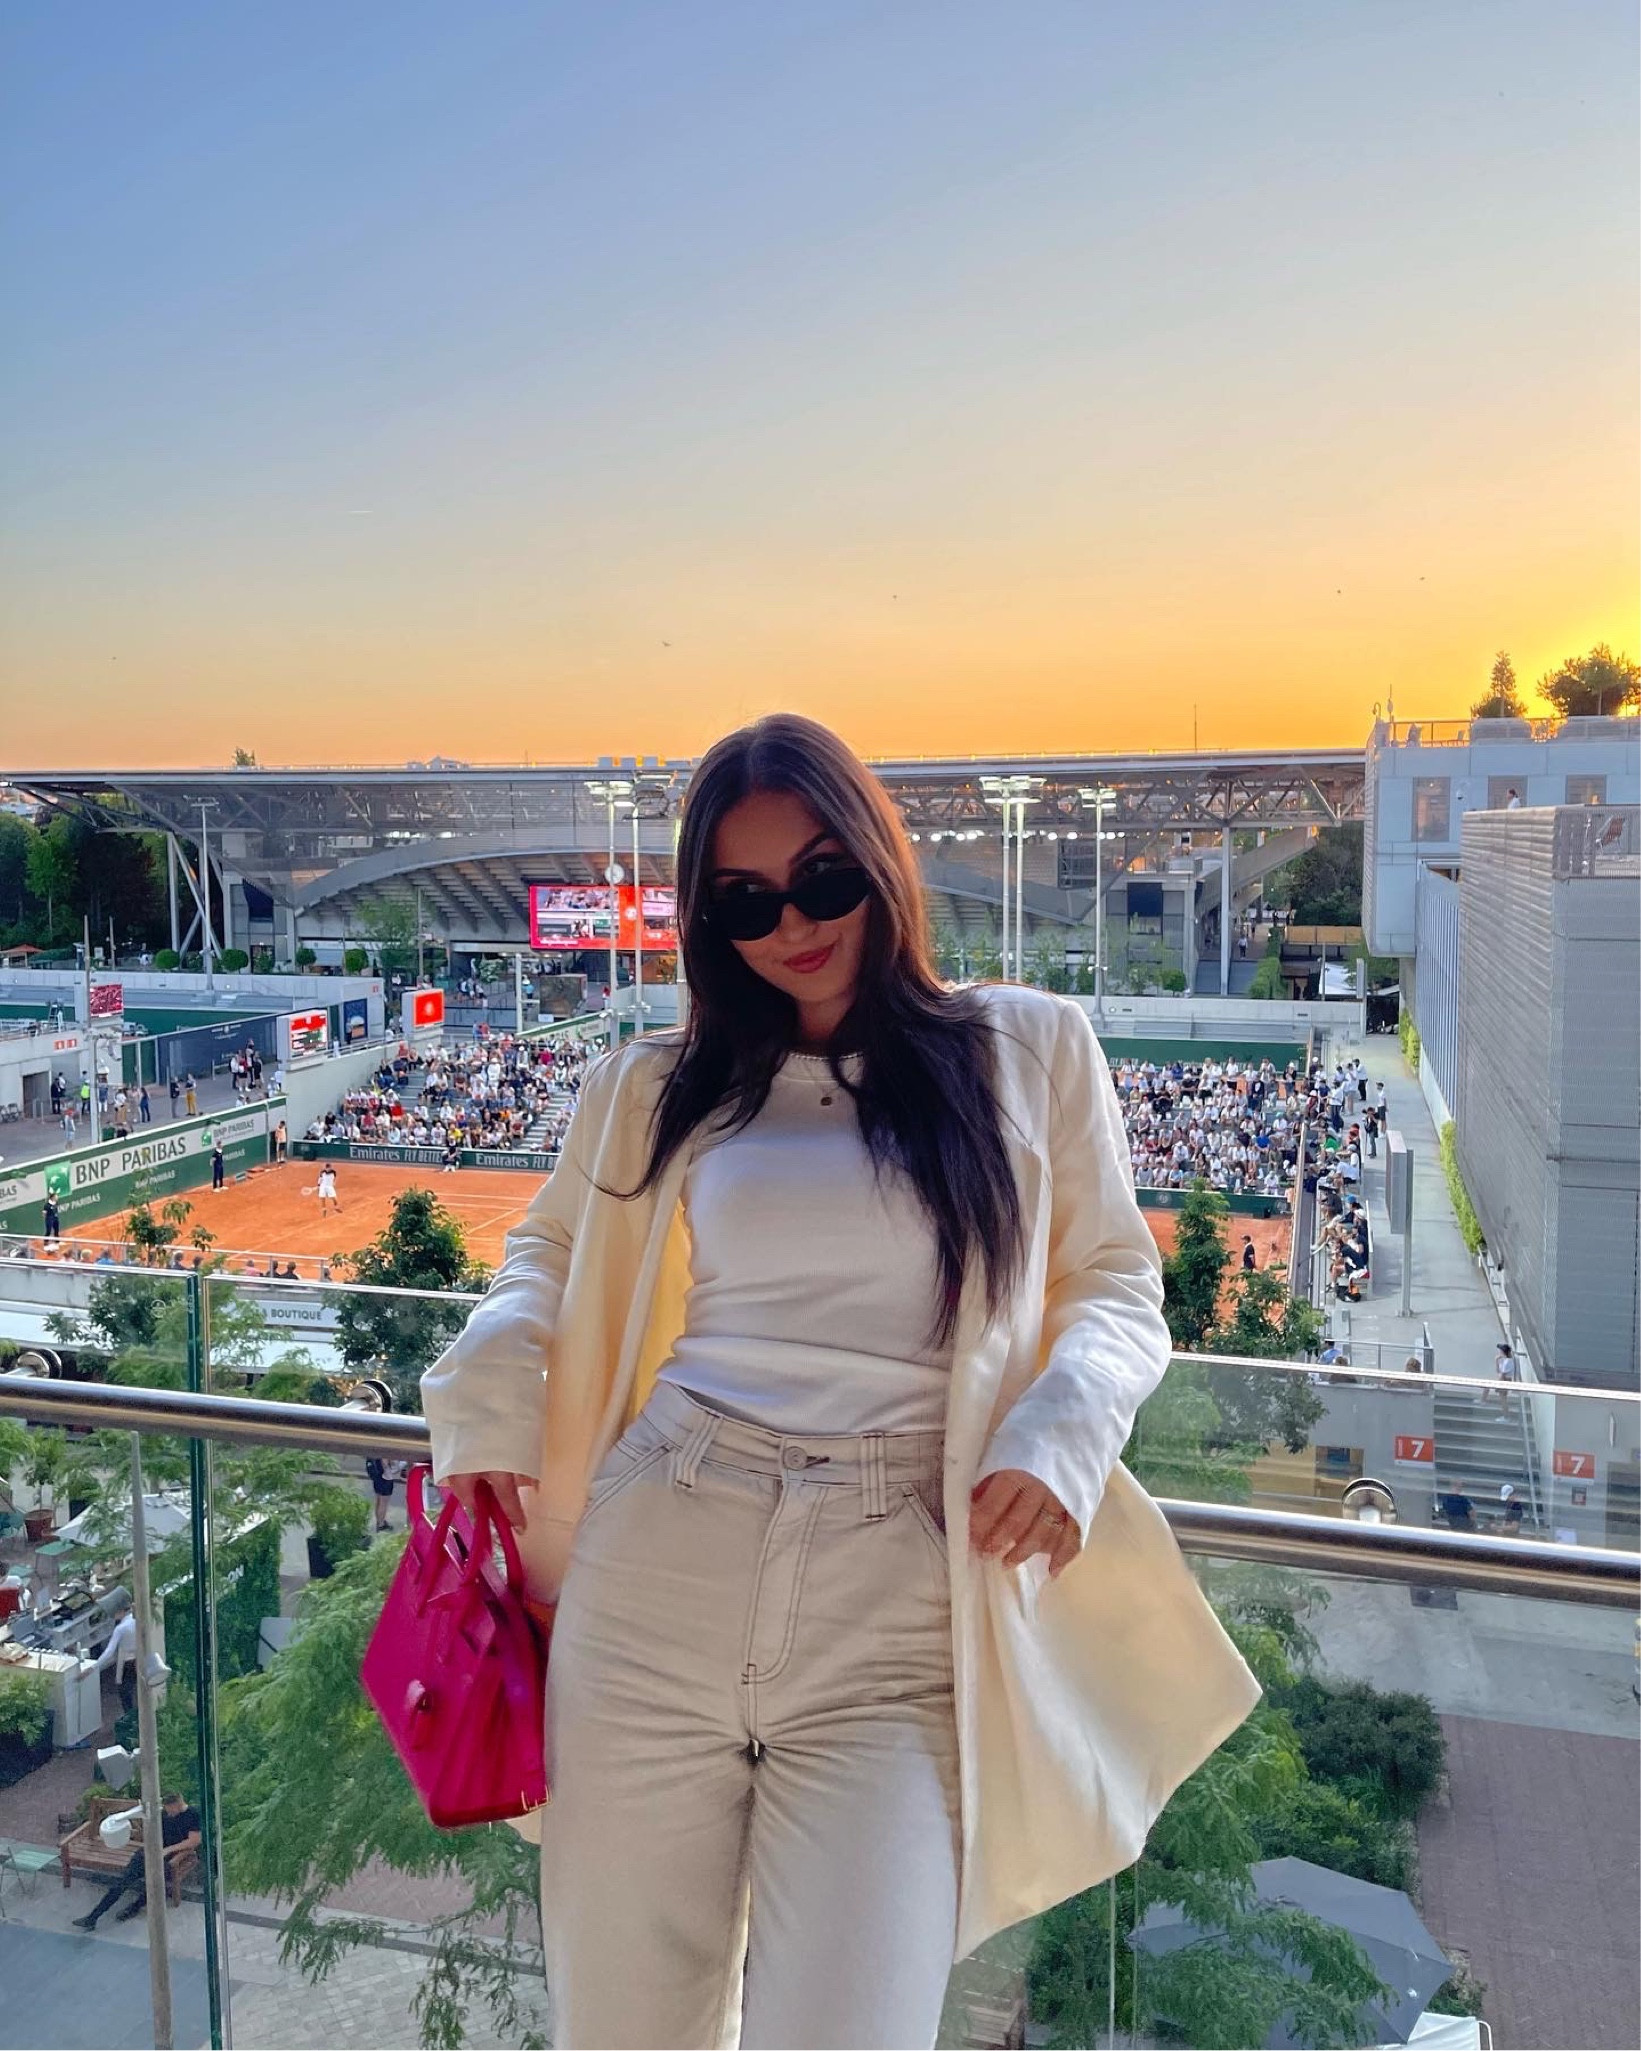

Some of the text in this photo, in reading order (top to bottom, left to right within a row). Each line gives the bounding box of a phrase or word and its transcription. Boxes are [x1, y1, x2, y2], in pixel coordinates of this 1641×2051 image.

[76, 1136, 187, 1185] BNP PARIBAS
[350, 1146, 443, 1163] Emirates FLY BETTE
[475, 1153, 529, 1168] Emirates
[270, 1308, 322, 1321] BOUTIQUE
[1411, 1440, 1425, 1459] 7
[1570, 1455, 1586, 1475] 7
